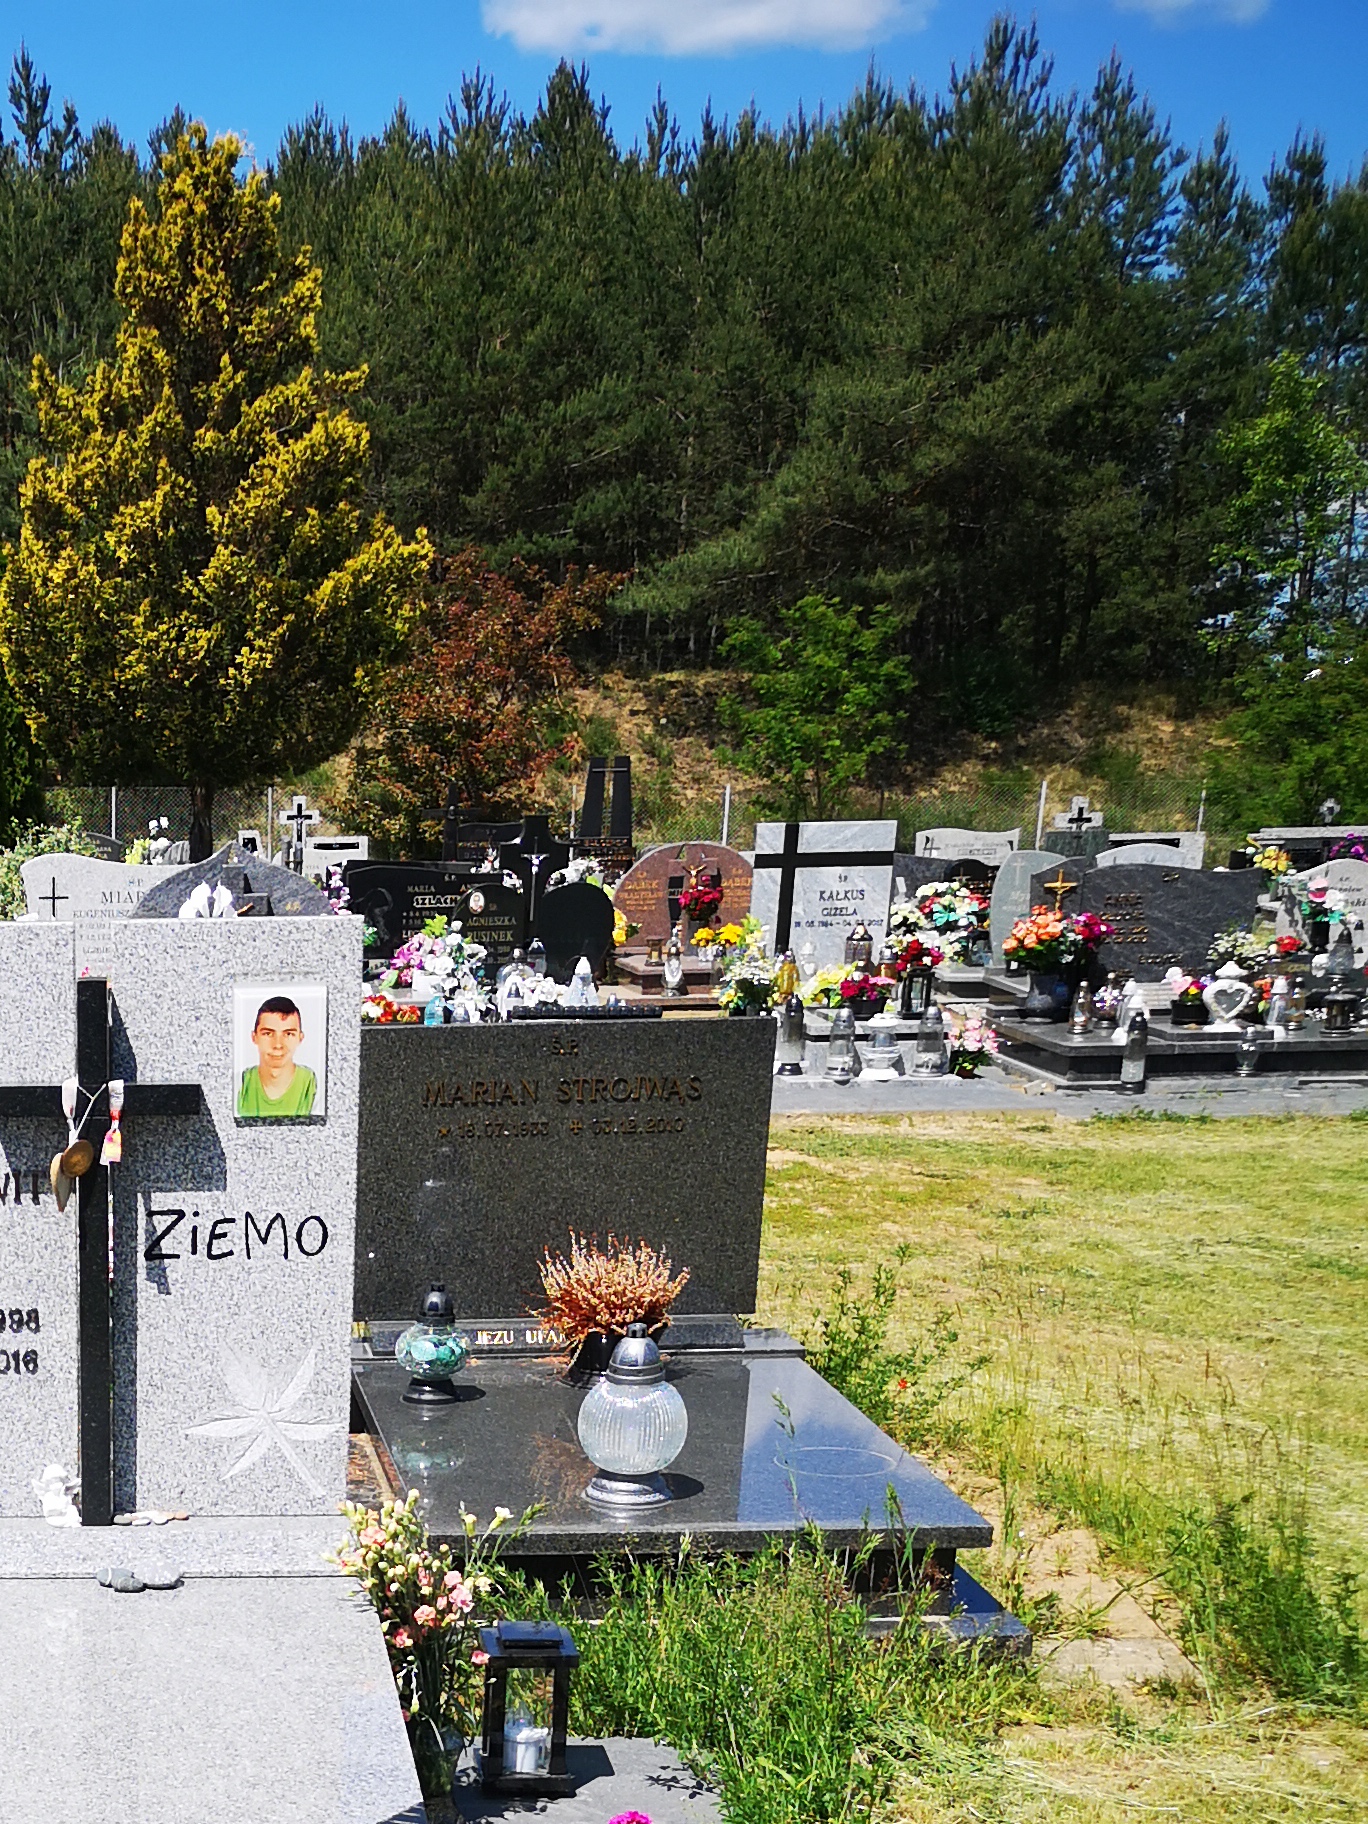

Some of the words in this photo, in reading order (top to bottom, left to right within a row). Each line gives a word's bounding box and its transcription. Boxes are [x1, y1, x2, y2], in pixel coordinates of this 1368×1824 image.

[467, 916, 517, 927] AGNIESZKA
[422, 1079, 539, 1107] MARIAN
[475, 1330, 514, 1345] JEZU
